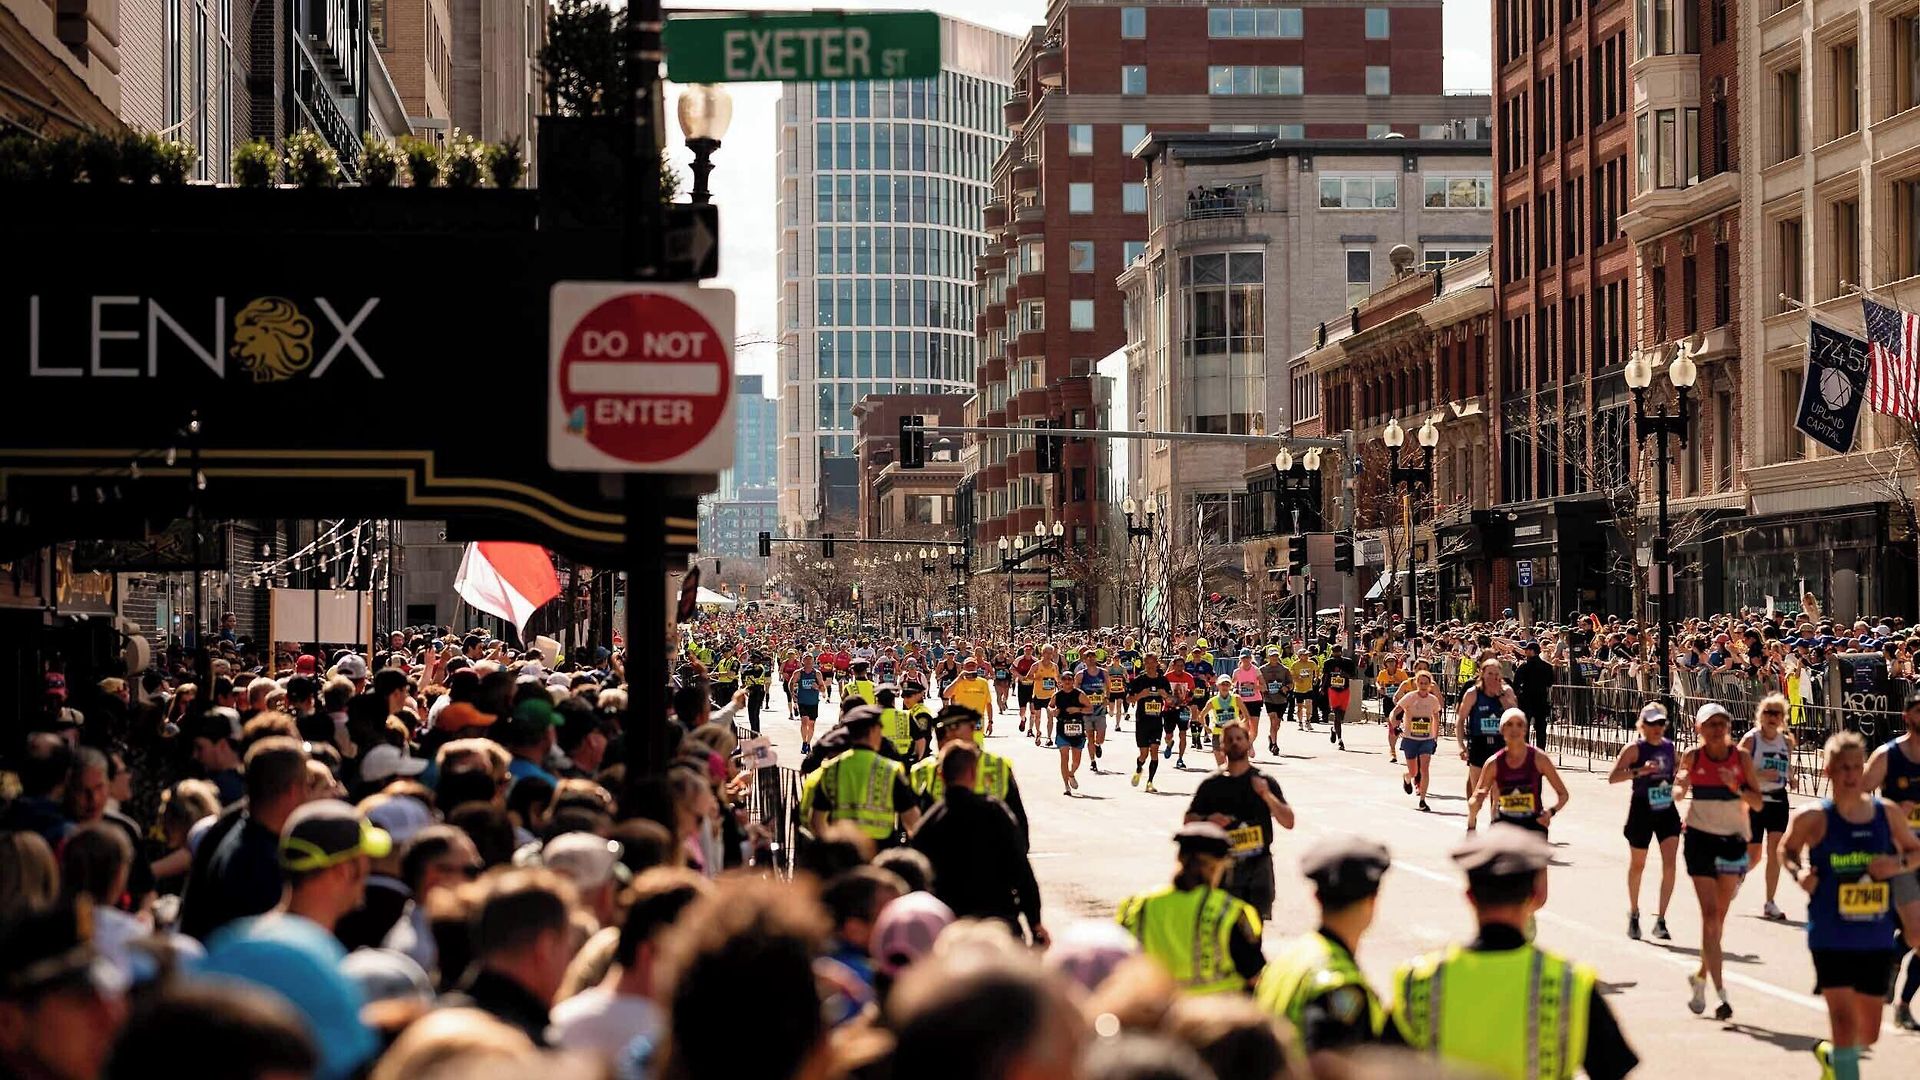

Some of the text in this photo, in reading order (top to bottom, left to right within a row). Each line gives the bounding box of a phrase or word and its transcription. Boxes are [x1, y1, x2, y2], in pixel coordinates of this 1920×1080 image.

[724, 27, 908, 79] EXETER ST
[582, 330, 708, 358] DO NOT
[594, 398, 694, 426] ENTER
[1806, 416, 1841, 444] CAPITAL
